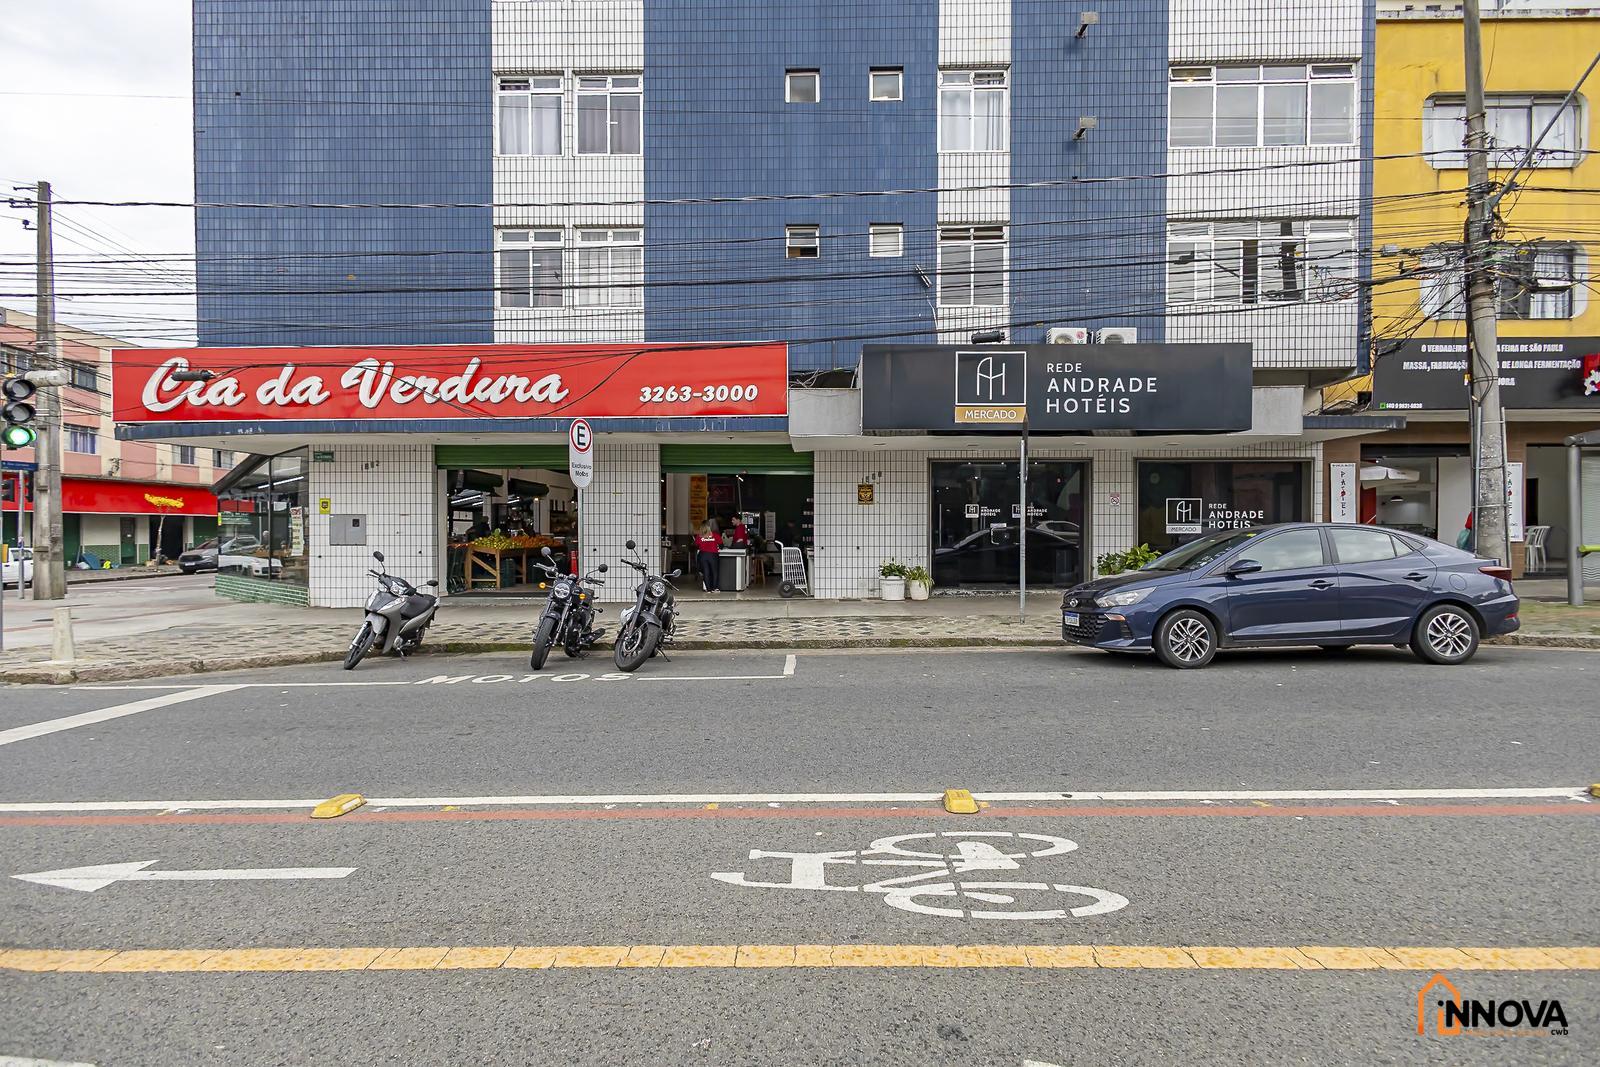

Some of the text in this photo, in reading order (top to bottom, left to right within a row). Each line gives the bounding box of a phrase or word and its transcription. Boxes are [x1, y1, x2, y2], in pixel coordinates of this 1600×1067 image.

[1427, 344, 1467, 352] VERDADEIRO
[1501, 344, 1519, 352] FEIRA
[1520, 344, 1528, 352] DE
[1529, 343, 1542, 352] SÃO
[1543, 344, 1563, 352] PAULO
[1047, 363, 1082, 373] REDE
[1403, 361, 1431, 372] MASSA,
[1502, 361, 1511, 369] DE
[1511, 361, 1533, 369] LONGA
[1534, 359, 1581, 370] FERMENTAÇÃO
[142, 357, 569, 412] Cia da Verdura
[1047, 377, 1157, 393] ANDRADE
[639, 384, 759, 403] 3263-3000
[1046, 394, 1131, 414] HOTÉIS
[965, 409, 1017, 420] MERCADO
[577, 425, 586, 446] E
[1208, 510, 1264, 519] ANDRADE
[1208, 519, 1251, 529] HOTÉIS
[414, 673, 634, 684] MOTOS
